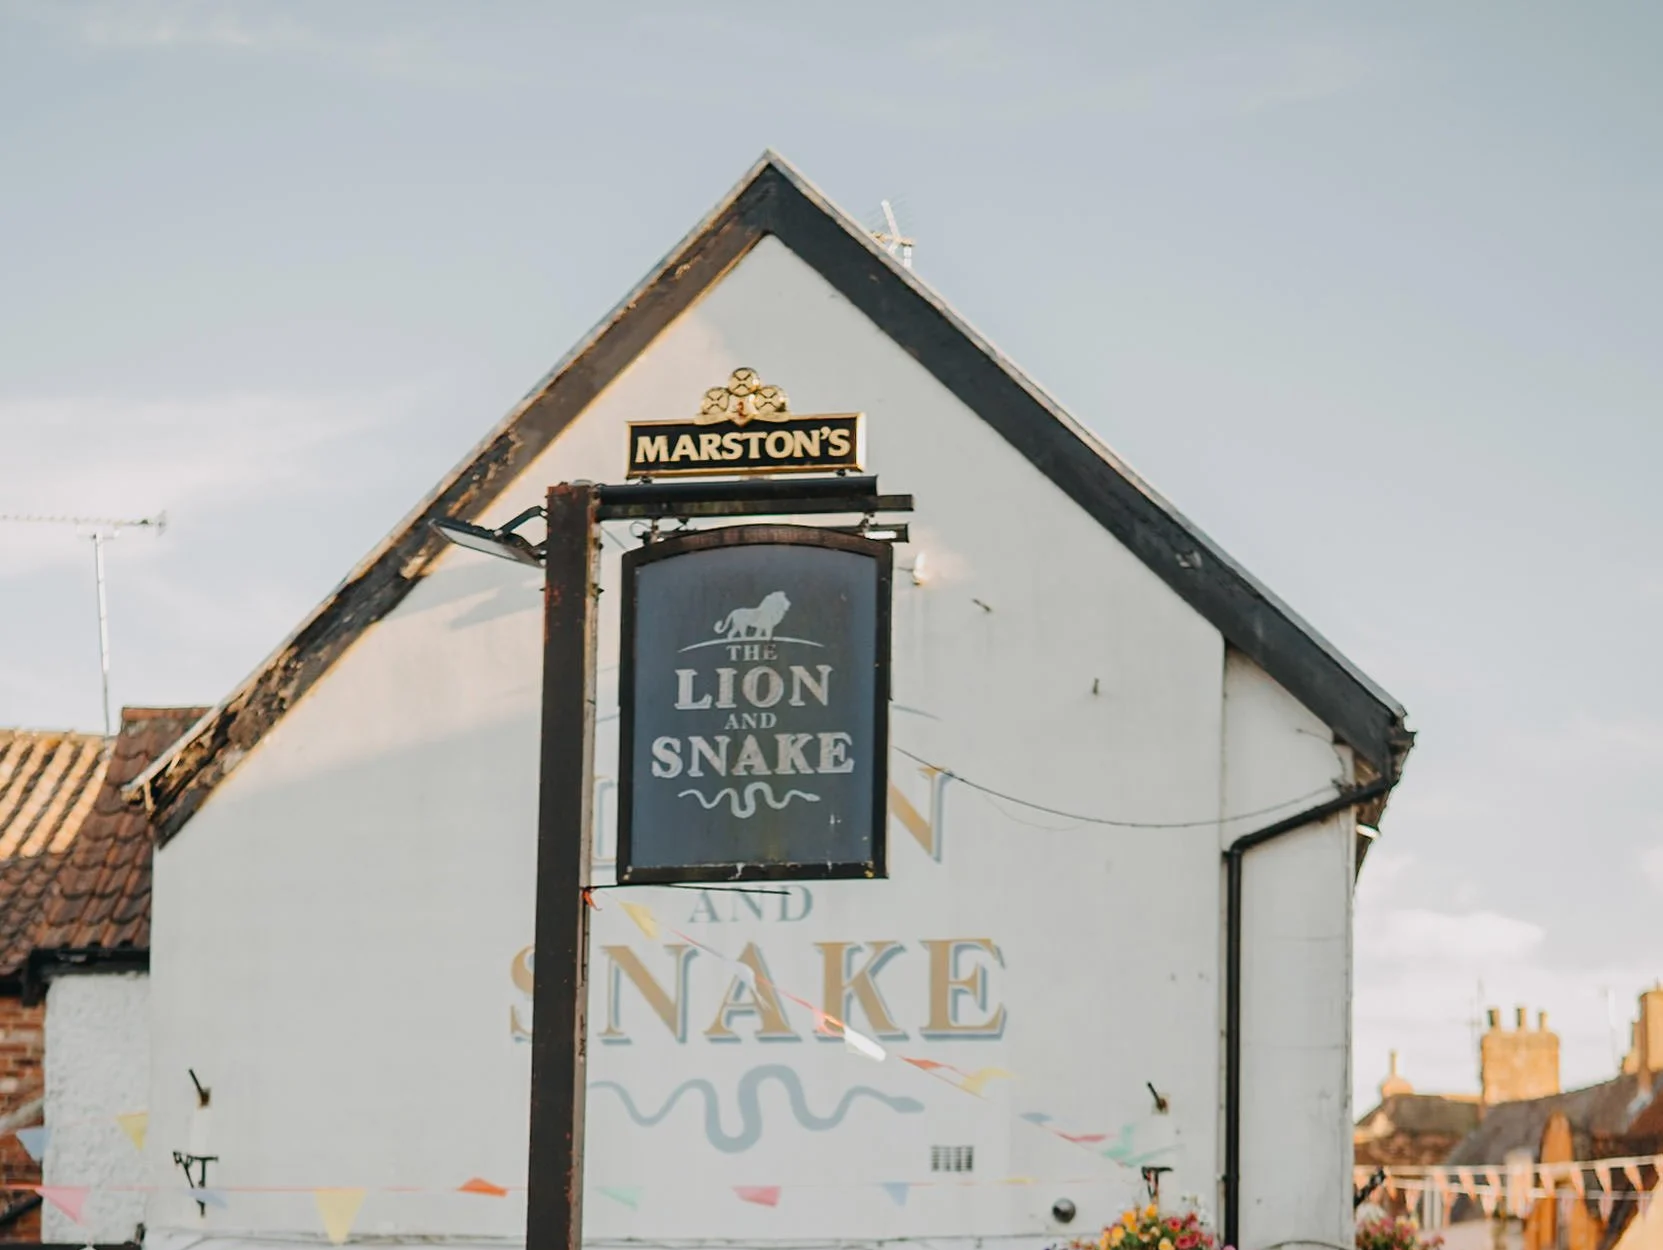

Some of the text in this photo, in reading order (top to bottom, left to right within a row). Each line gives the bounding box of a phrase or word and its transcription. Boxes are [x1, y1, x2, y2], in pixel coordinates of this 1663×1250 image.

[634, 426, 851, 464] MARSTON'S
[726, 643, 779, 662] THE
[674, 664, 834, 710] LION
[724, 712, 777, 731] AND
[651, 731, 856, 779] SNAKE
[688, 882, 815, 924] AND
